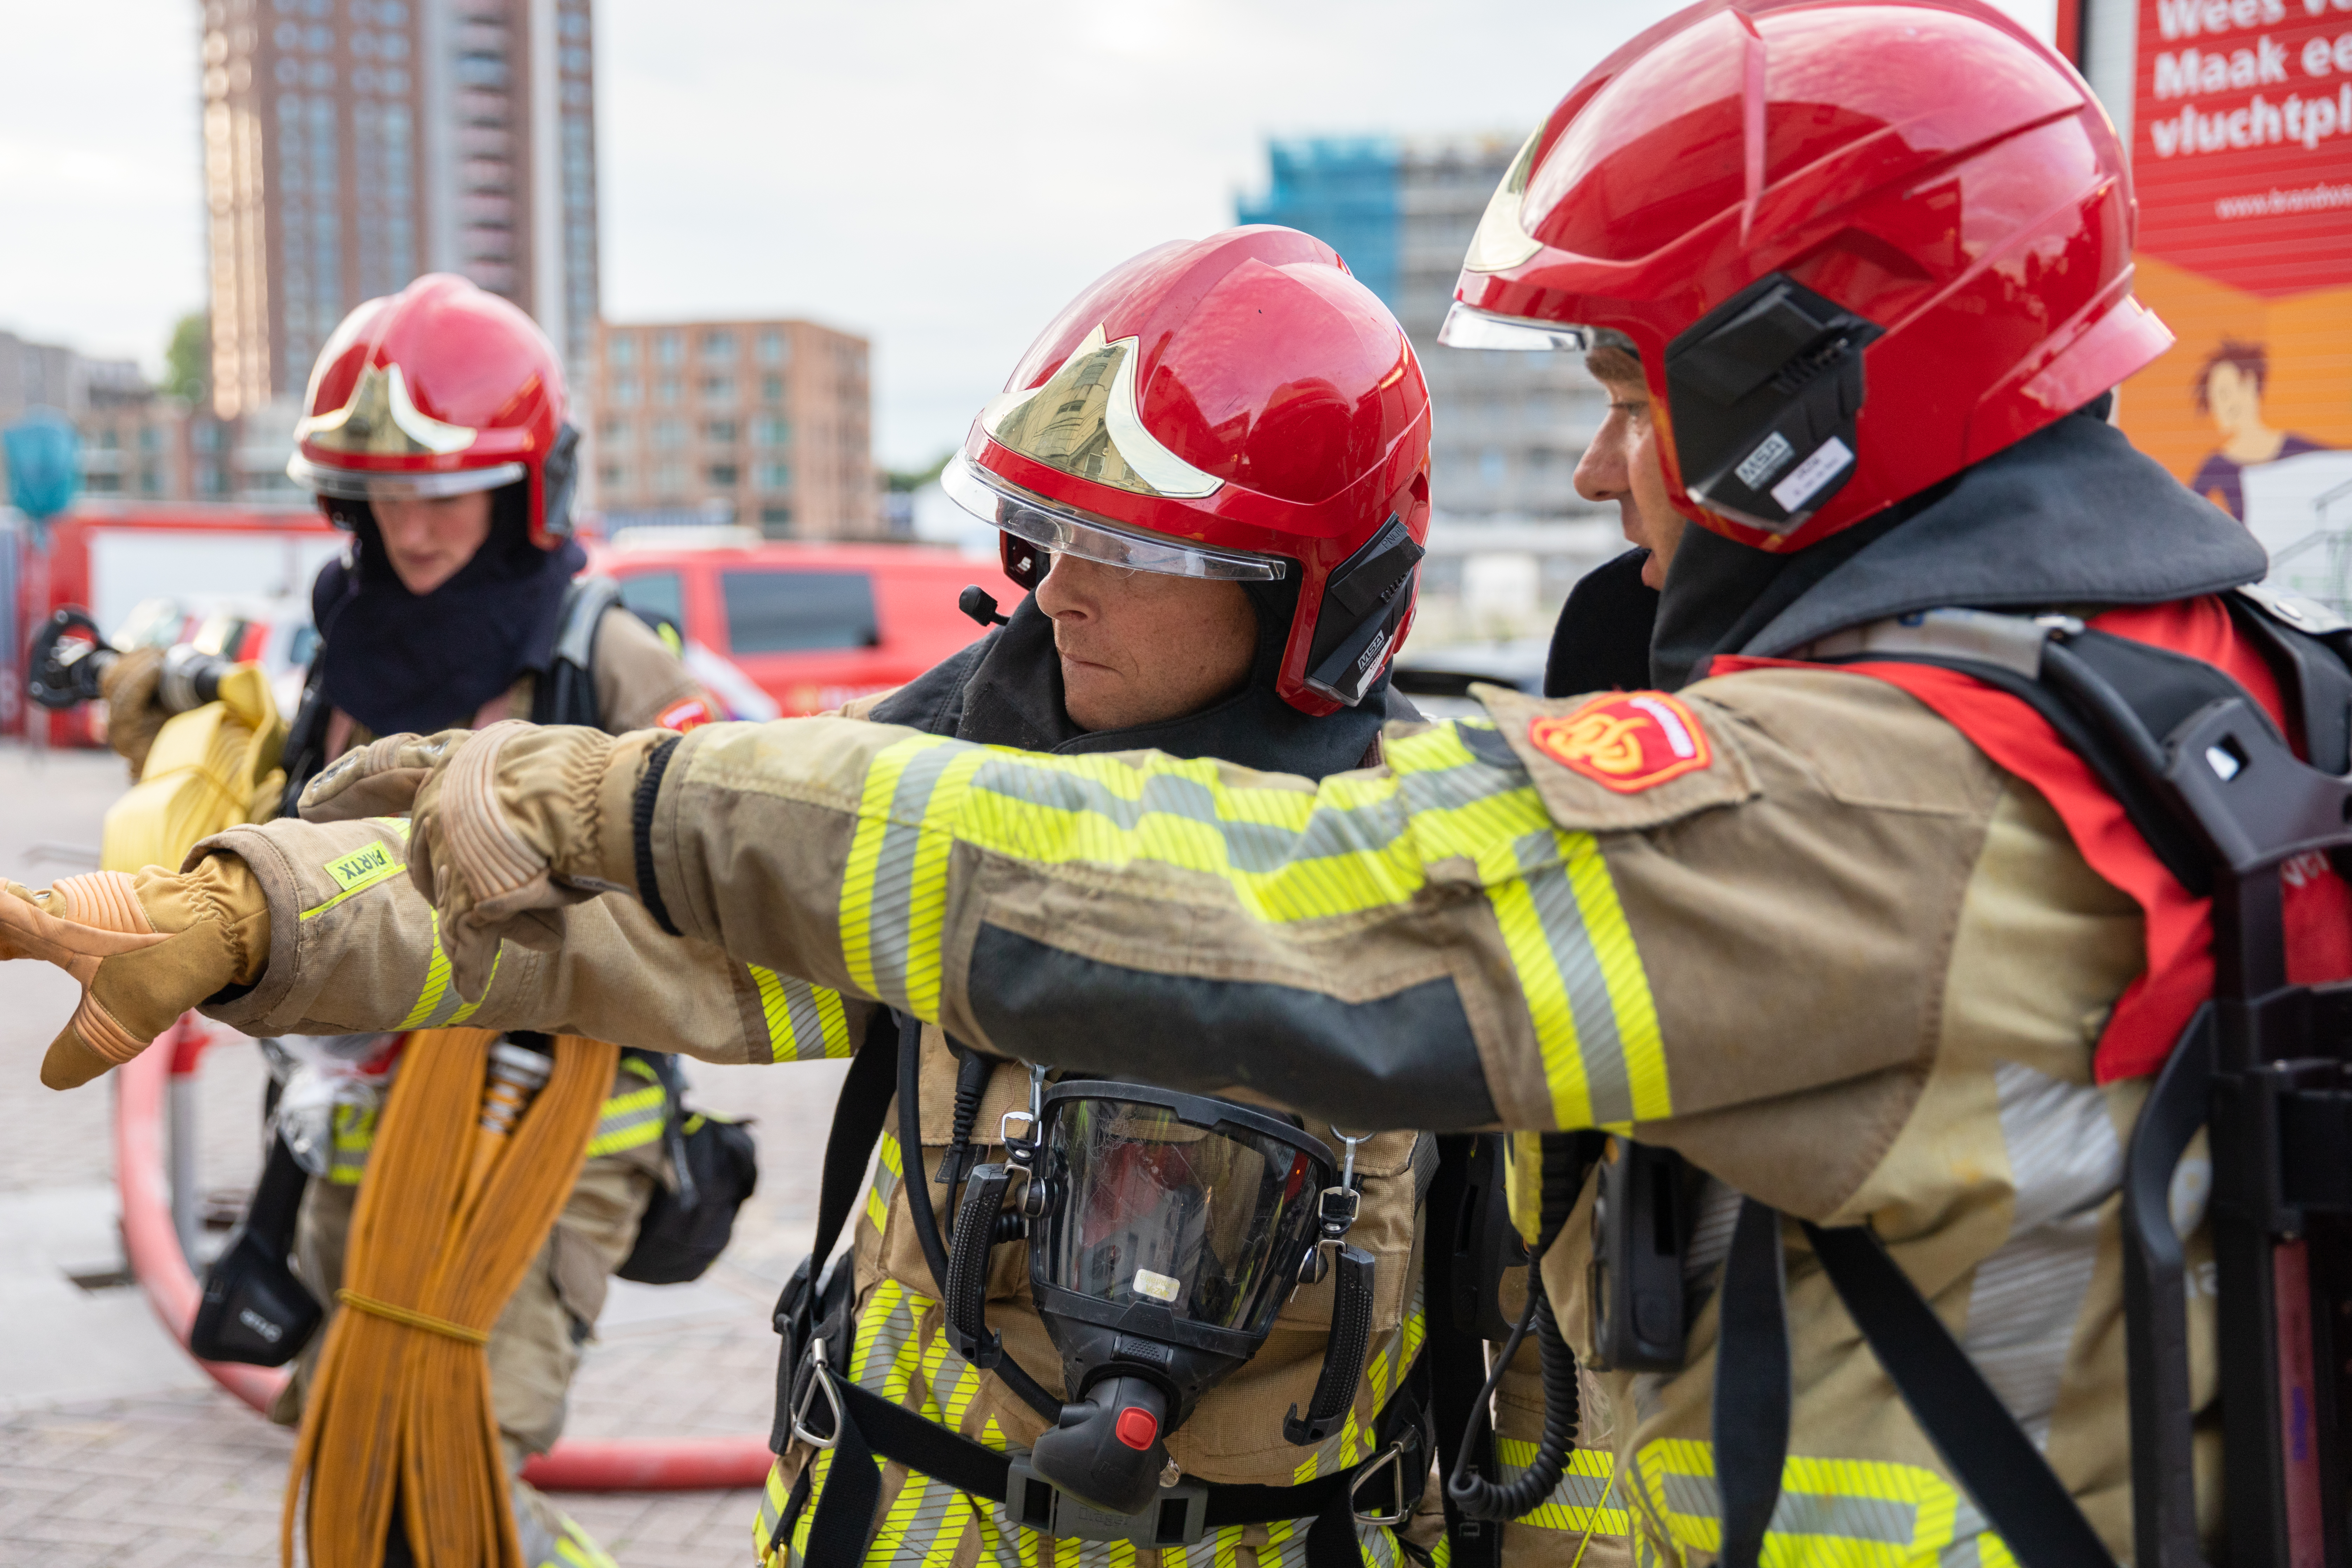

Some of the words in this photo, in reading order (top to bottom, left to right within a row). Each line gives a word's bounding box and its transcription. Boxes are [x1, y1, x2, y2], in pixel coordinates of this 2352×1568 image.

[2153, 34, 2289, 101] Maak
[2150, 81, 2352, 158] vluchtpl
[1740, 438, 1784, 476] MSA
[1359, 635, 1383, 668] MSA
[1366, 656, 1374, 668] Safety
[1373, 641, 1385, 657] Company
[338, 849, 387, 880] PARTX
